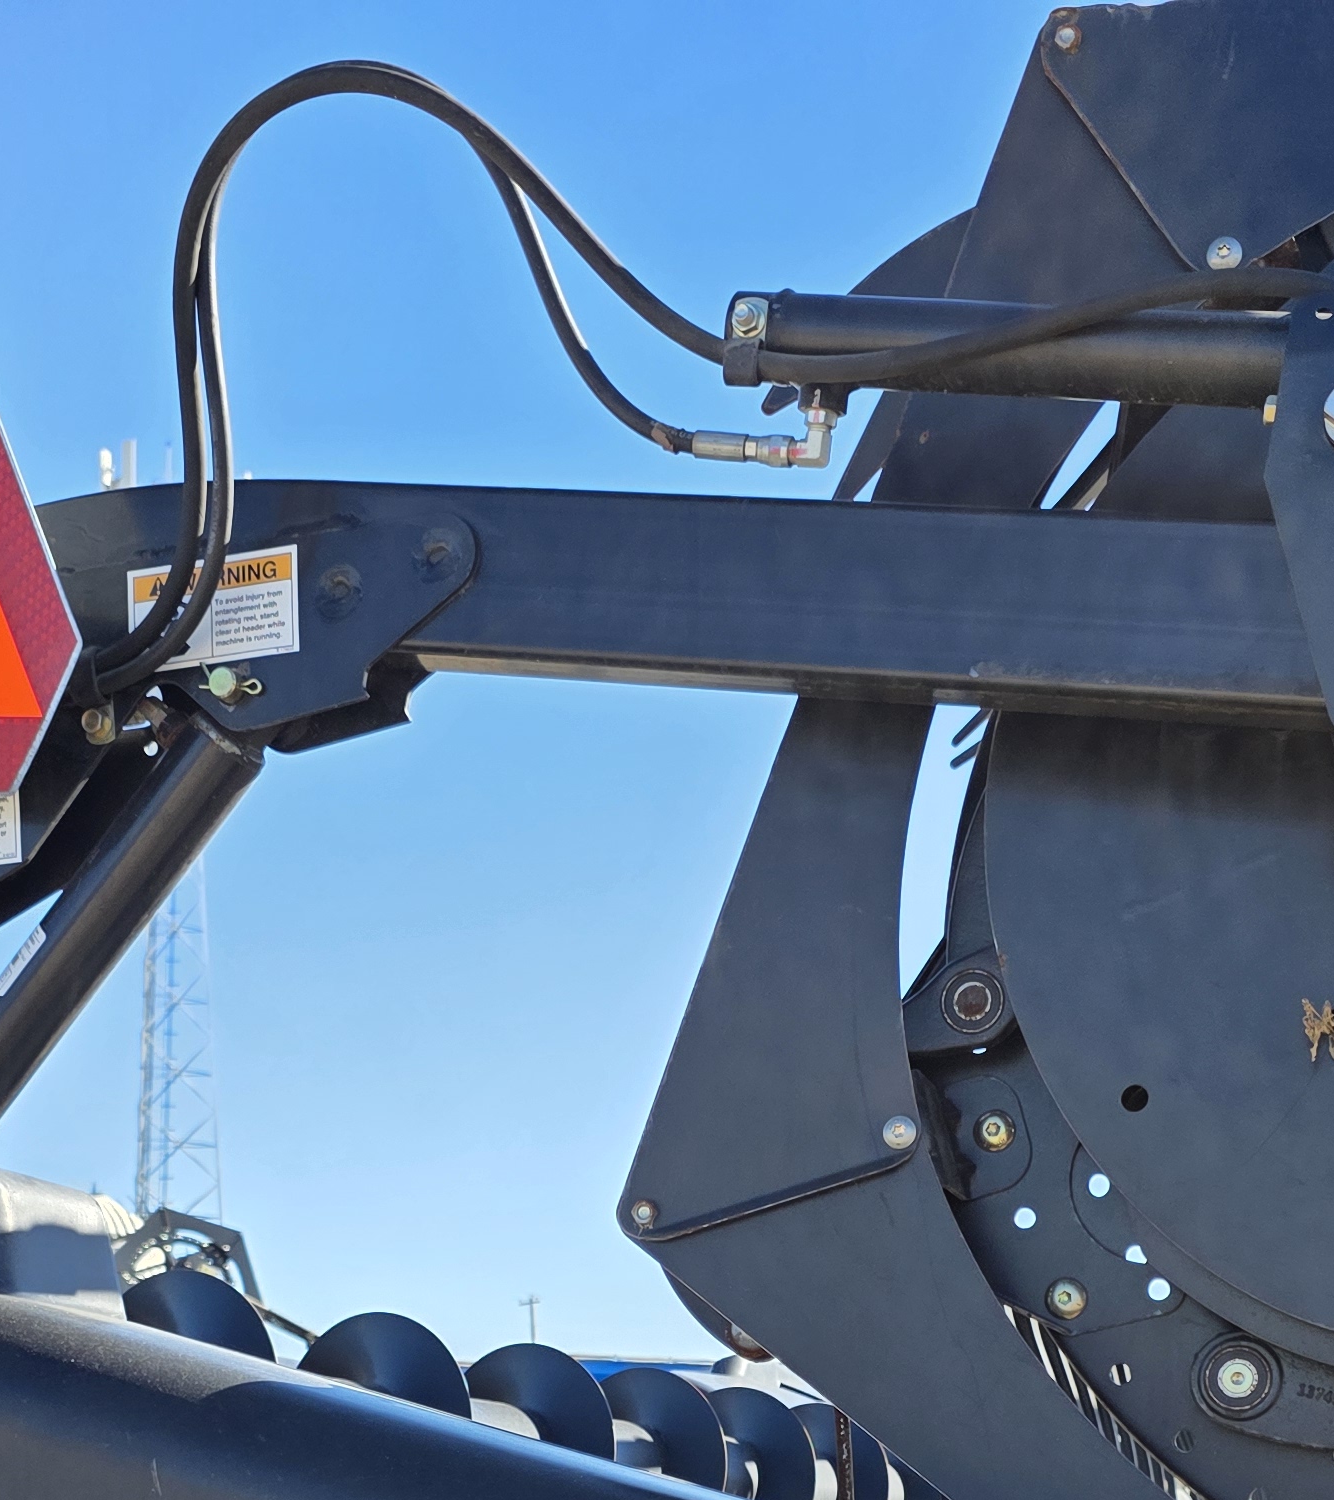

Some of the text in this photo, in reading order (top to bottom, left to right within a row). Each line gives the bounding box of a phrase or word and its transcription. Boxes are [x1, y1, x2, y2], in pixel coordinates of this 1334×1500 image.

[215, 590, 282, 606] To avoid injury from
[214, 600, 277, 616] entanglement with
[215, 617, 241, 627] rotating
[260, 610, 279, 620] stand
[215, 620, 285, 637] clear of header while
[215, 637, 244, 647] machine
